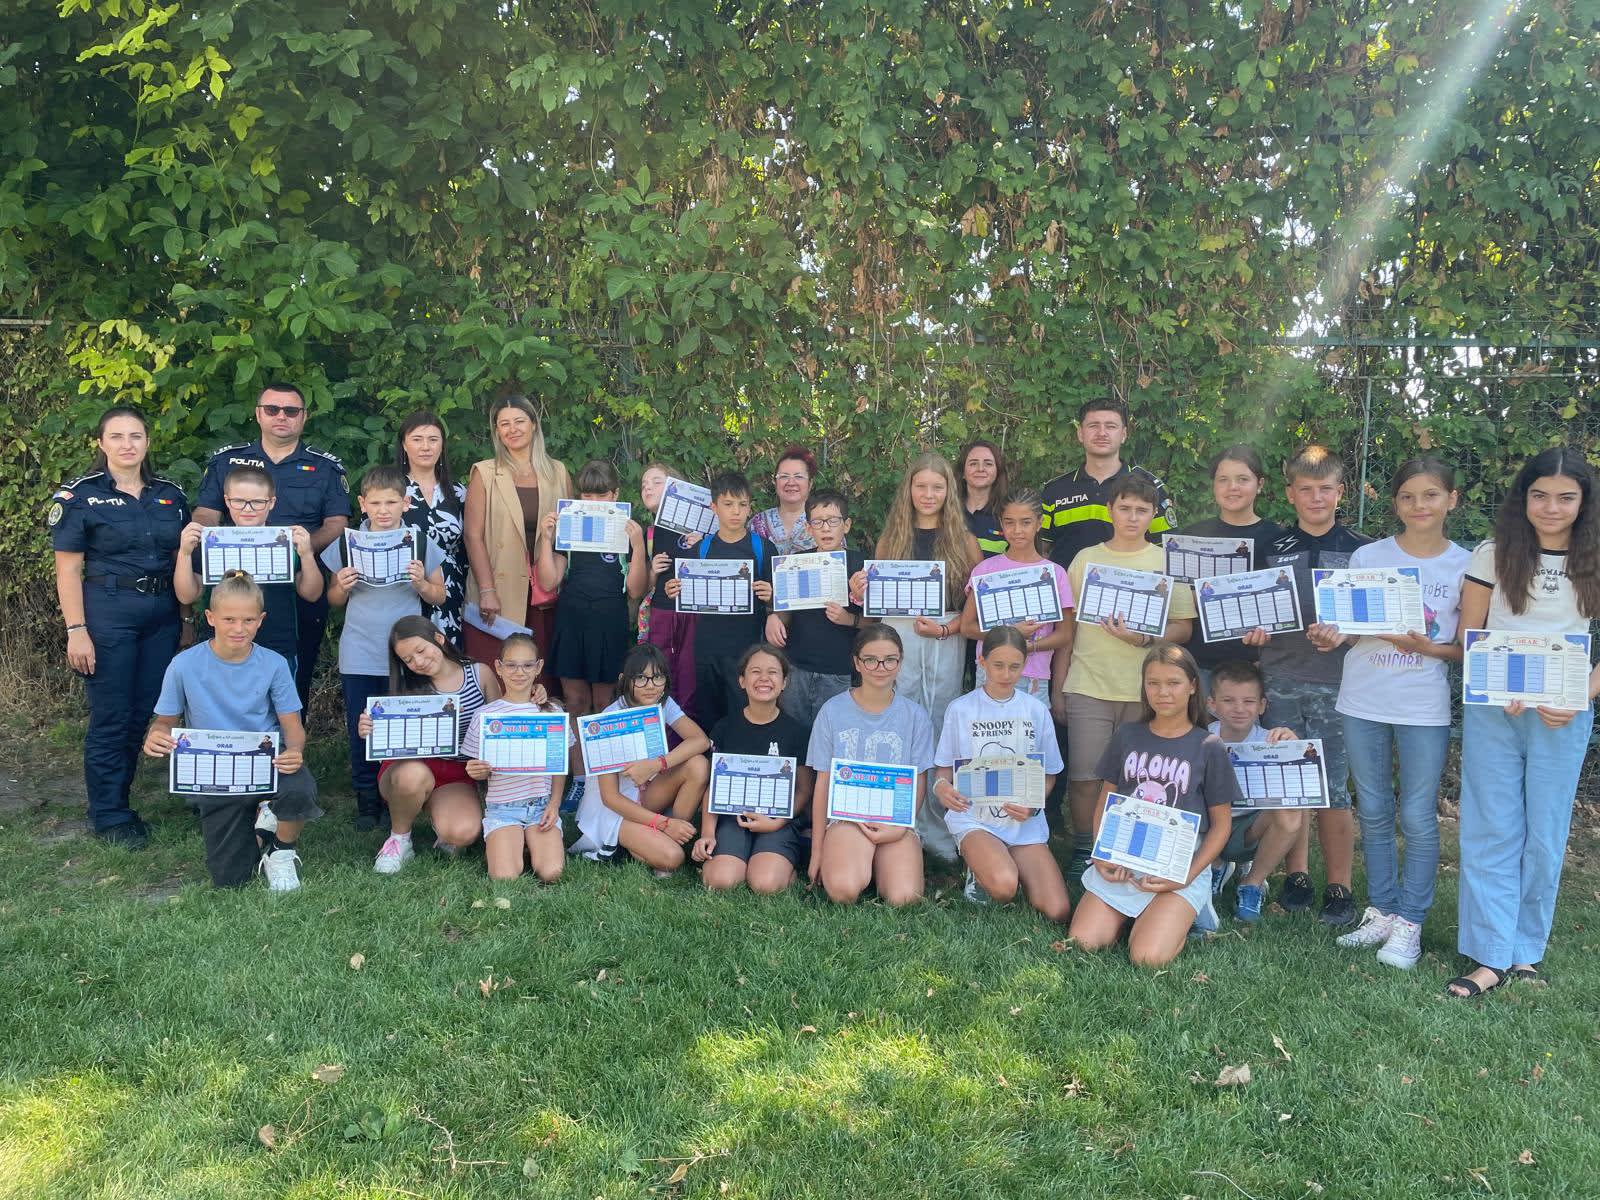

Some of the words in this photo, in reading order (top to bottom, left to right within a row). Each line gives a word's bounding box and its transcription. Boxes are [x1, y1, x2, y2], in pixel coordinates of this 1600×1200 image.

[972, 720, 1014, 731] SNOOPY
[1024, 729, 1036, 740] 15
[1124, 750, 1191, 794] ALOHA
